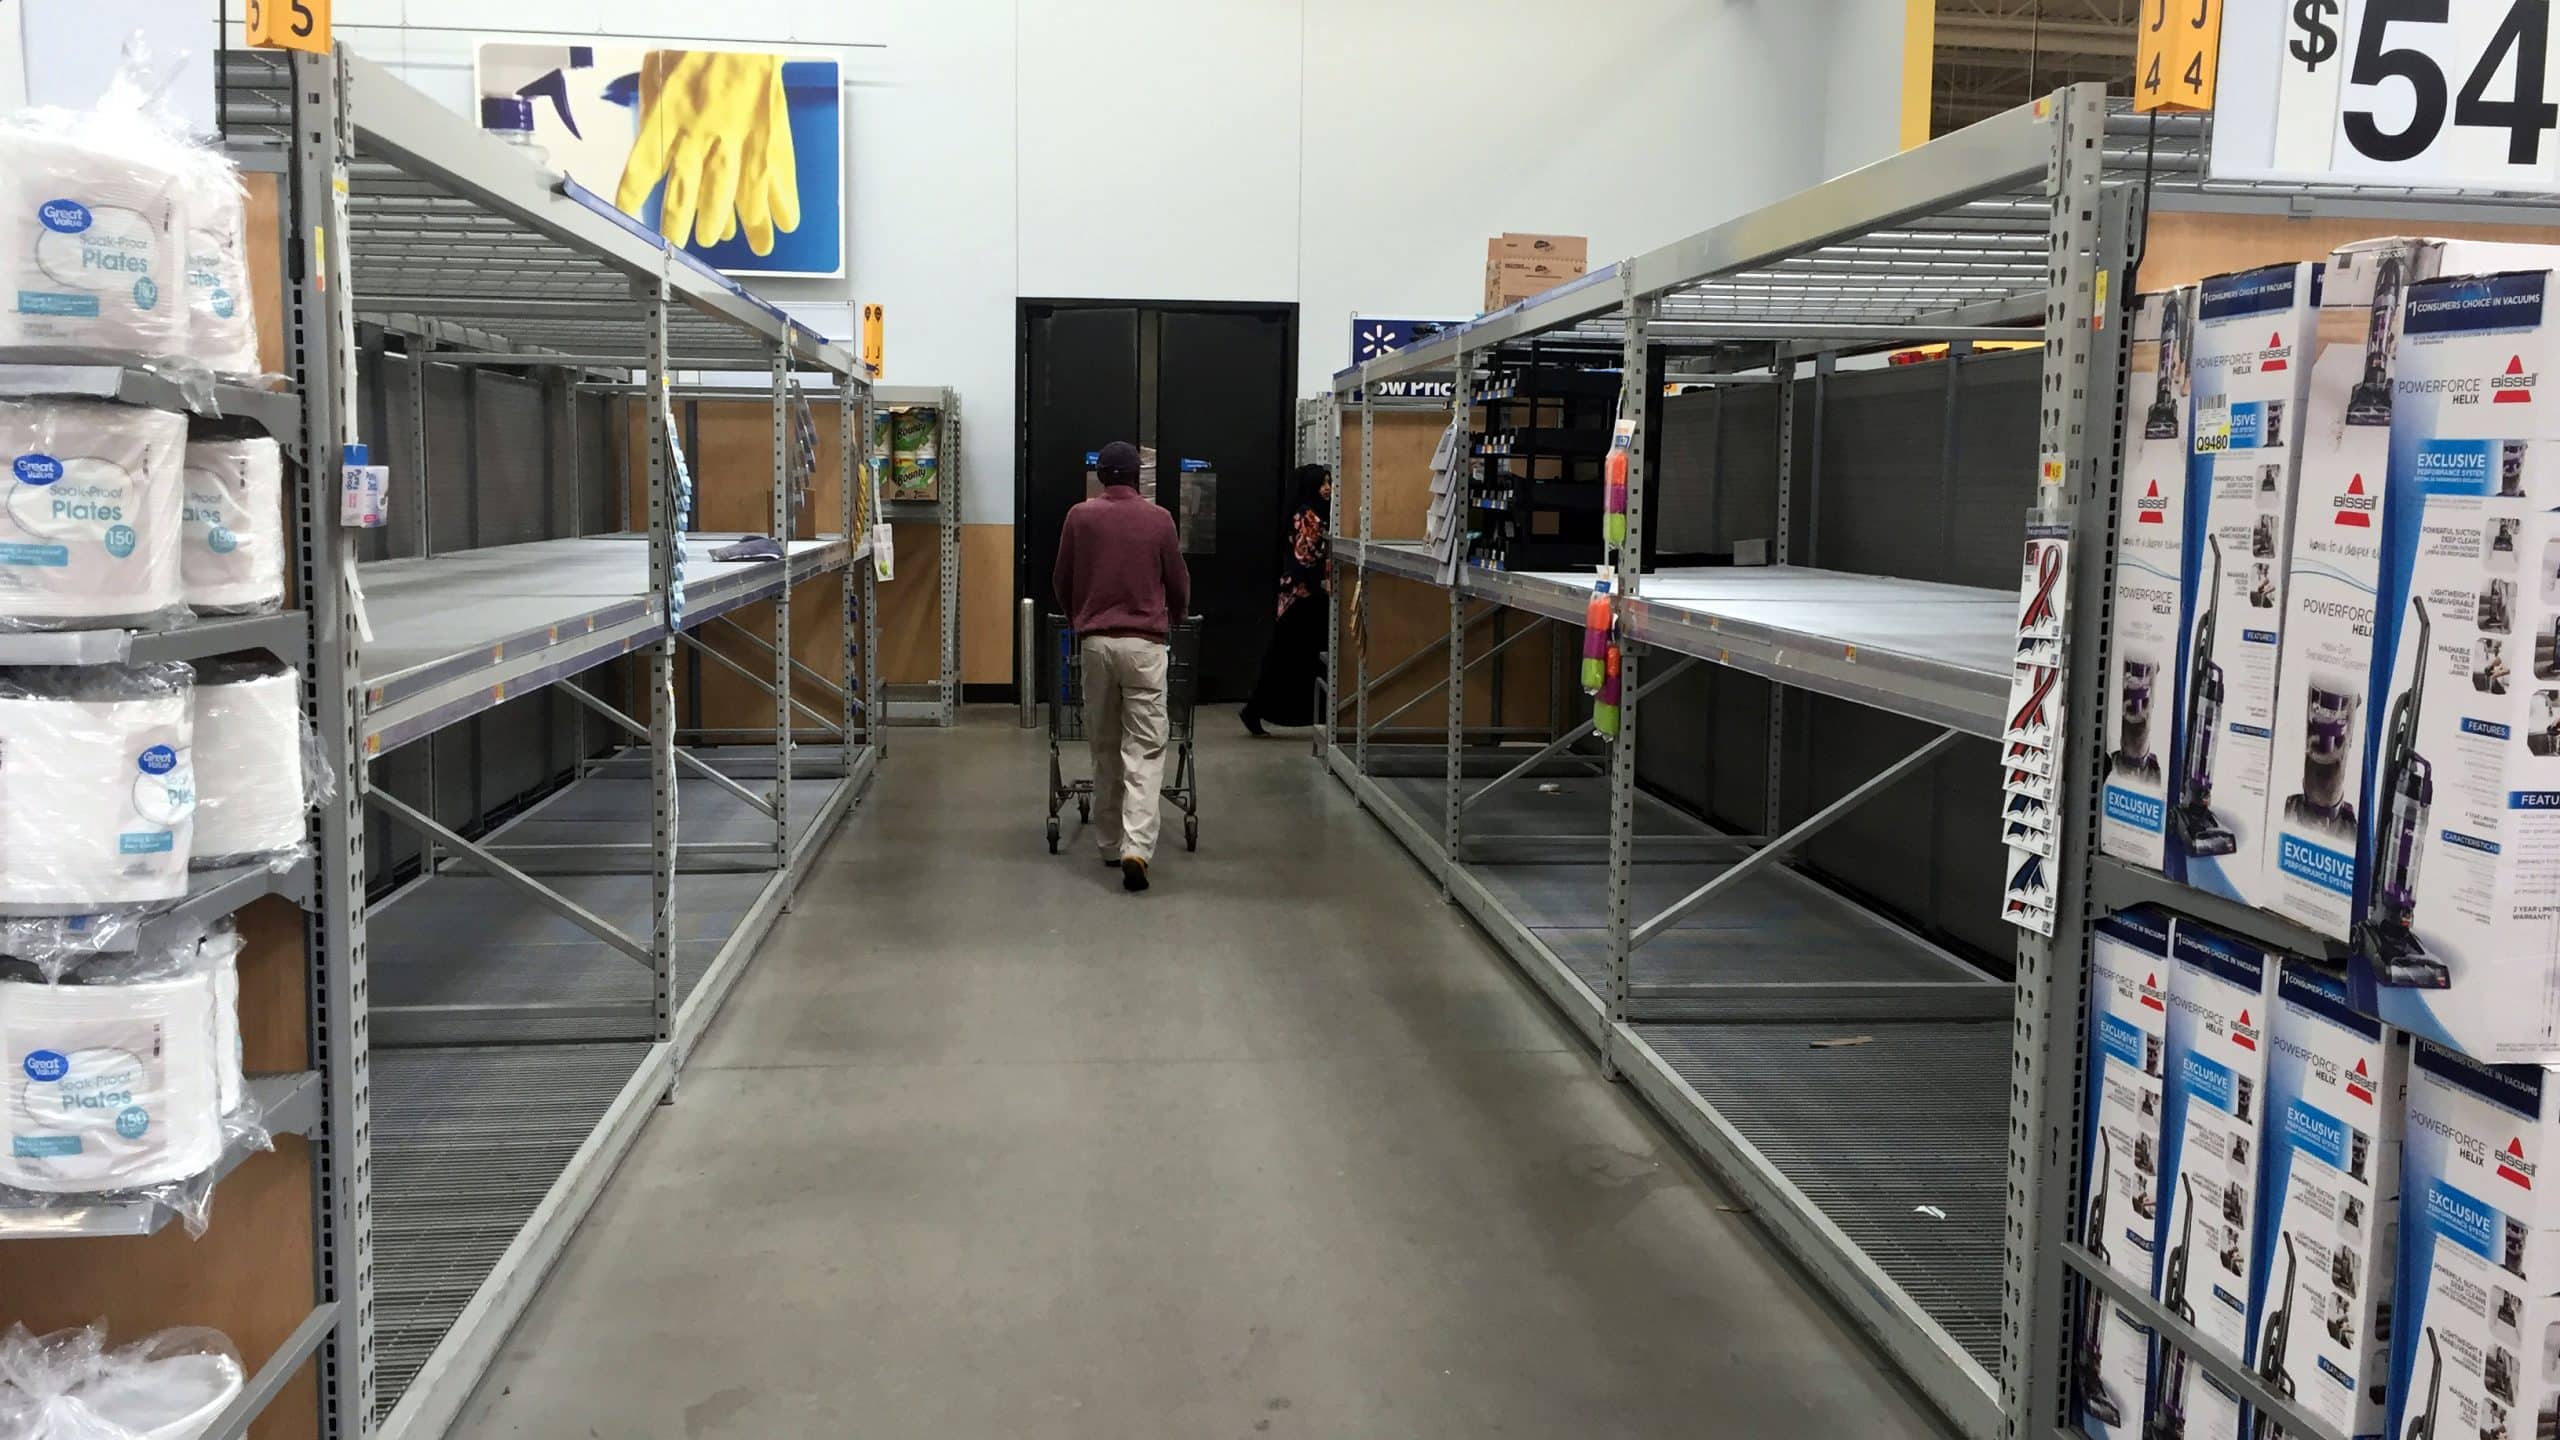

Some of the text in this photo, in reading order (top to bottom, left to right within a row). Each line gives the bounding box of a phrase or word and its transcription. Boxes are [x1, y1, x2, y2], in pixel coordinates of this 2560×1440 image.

[2145, 51, 2161, 95] 4
[2184, 51, 2202, 95] 4
[44, 206, 82, 220] Great
[53, 217, 82, 227] Value
[82, 249, 148, 272] Plates
[2239, 286, 2258, 297] CHOICE
[2259, 285, 2266, 293] IN
[2266, 281, 2293, 292] VACUUMS
[2462, 298, 2491, 309] CHOICE
[2492, 297, 2501, 306] IN
[2502, 294, 2540, 305] VACUUMS
[2195, 352, 2254, 369] POWERFORCE
[2232, 366, 2251, 375] HELIX
[2399, 378, 2481, 394] POWERFORCE
[2452, 395, 2479, 405] HELIX
[897, 422, 926, 440] Bounty
[2197, 435, 2228, 451] Q9480
[17, 461, 54, 472] Great
[2417, 453, 2486, 468] EXCLUSIVE
[27, 470, 54, 479] Value
[897, 469, 926, 485] Bounty
[2417, 468, 2485, 478] PERFORMANCE SYSTEM
[50, 485, 122, 498] Soak-Proof
[52, 500, 122, 521] Plates
[109, 531, 134, 545] 150
[2455, 528, 2481, 537] SUCTION
[2119, 586, 2173, 604] POWERFORCE
[2428, 597, 2475, 608] MANEUVERABLE
[2152, 604, 2171, 615] HELIX
[2438, 645, 2471, 655] WASHABLE
[2450, 654, 2470, 664] FILTER
[143, 752, 171, 763] Great
[2108, 791, 2159, 819] EXCLUSIVE
[2284, 841, 2354, 880] EXCLUSIVE
[2284, 859, 2327, 882] PERFORMANCE
[2118, 987, 2133, 999] HELIX
[2323, 988, 2346, 1004] CHOICE
[2169, 993, 2224, 1027] POWERFORCE
[2100, 1021, 2138, 1048] EXCLUSIVE
[2205, 1022, 2224, 1037] HELIX
[28, 1057, 59, 1069] Great
[2273, 1035, 2337, 1075] POWERFORCE
[36, 1067, 59, 1075] Value
[2183, 1058, 2229, 1089] EXCLUSIVE
[2315, 1070, 2337, 1087] HELIX
[2494, 1070, 2503, 1081] IN
[2503, 1074, 2538, 1097] VACUUMS
[62, 1090, 132, 1110] Plates
[2287, 1106, 2341, 1145] EXCLUSIVE
[2411, 1110, 2486, 1156] POWERFORCE
[2459, 1148, 2485, 1168] HELIX
[2428, 1188, 2491, 1233] EXCLUSIVE
[2428, 1204, 2490, 1241] PERFORMANCE SYSTEM
